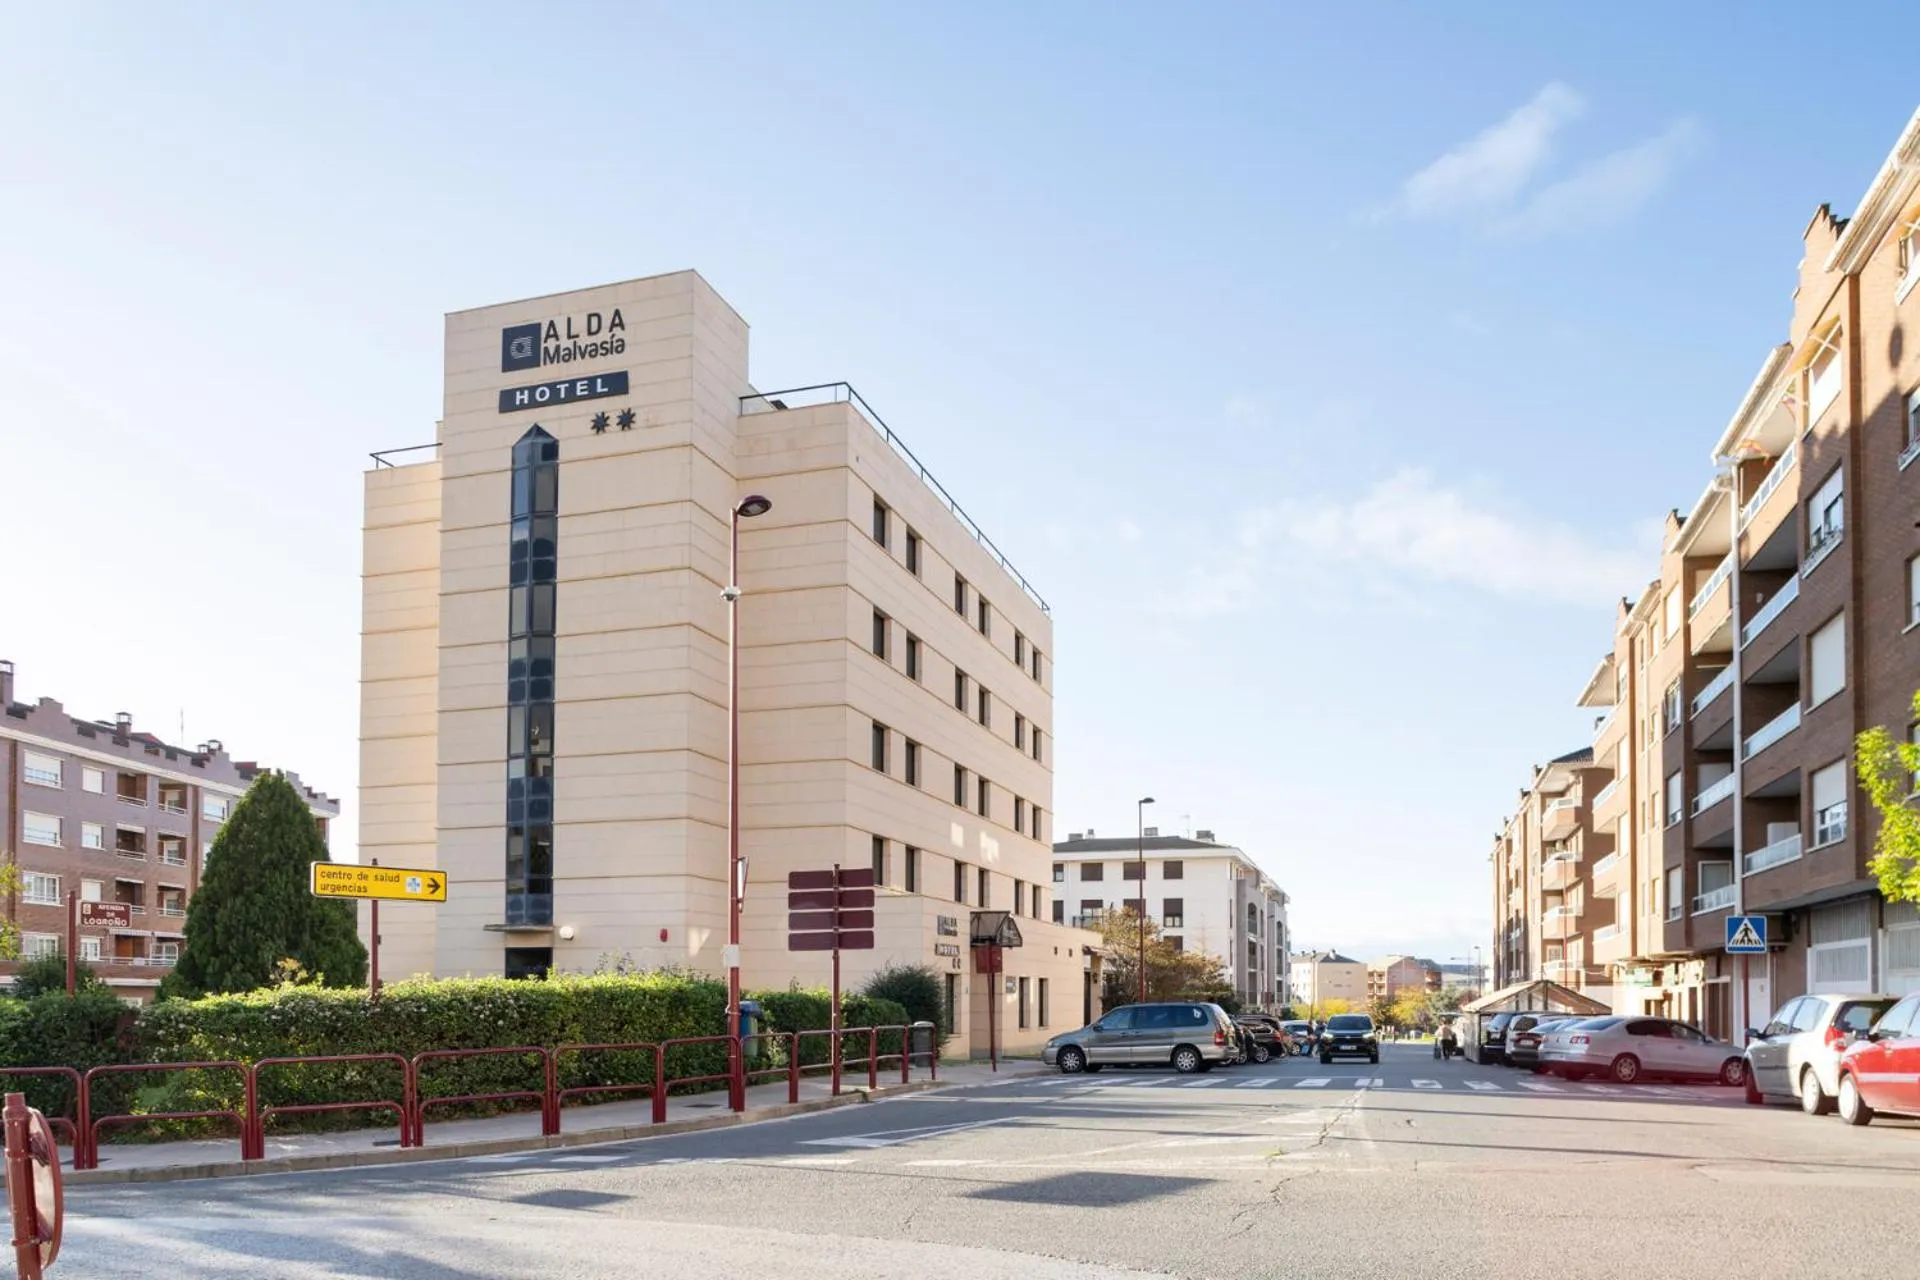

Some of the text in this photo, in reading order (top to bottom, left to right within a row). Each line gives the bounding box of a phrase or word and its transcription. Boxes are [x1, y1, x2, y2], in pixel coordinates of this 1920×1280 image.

[543, 308, 626, 344] ALDA
[543, 334, 626, 366] Malvasía
[515, 378, 609, 405] HOTEL
[319, 870, 401, 883] centro de salud
[319, 882, 369, 893] urgencias
[83, 917, 128, 927] LOGROÑO
